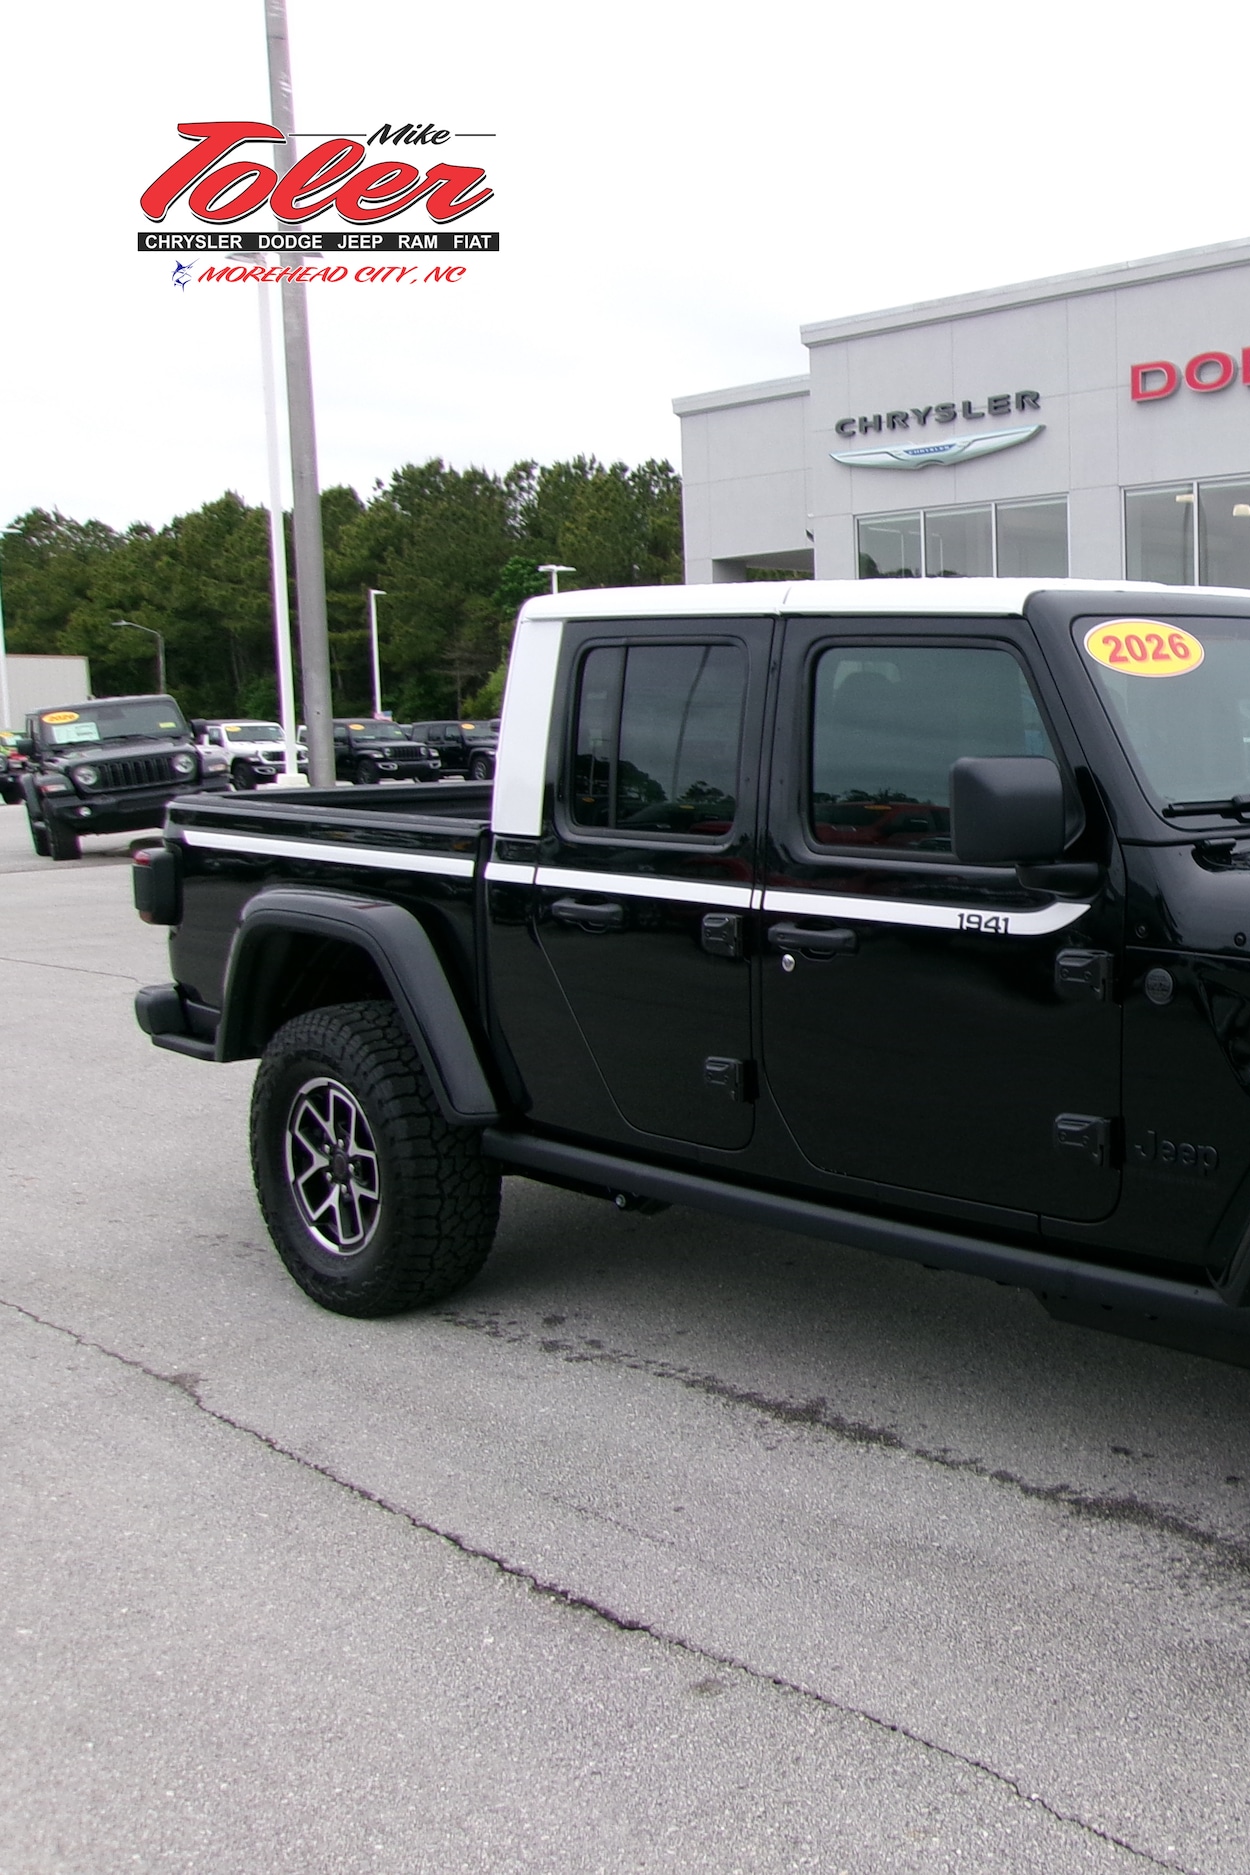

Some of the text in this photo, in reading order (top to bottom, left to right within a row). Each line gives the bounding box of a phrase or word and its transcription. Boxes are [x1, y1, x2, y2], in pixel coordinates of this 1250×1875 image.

[835, 390, 1040, 437] CHRYSLER
[1102, 632, 1190, 664] 2026
[957, 913, 1009, 934] 1941
[1134, 1130, 1219, 1176] Jeep
